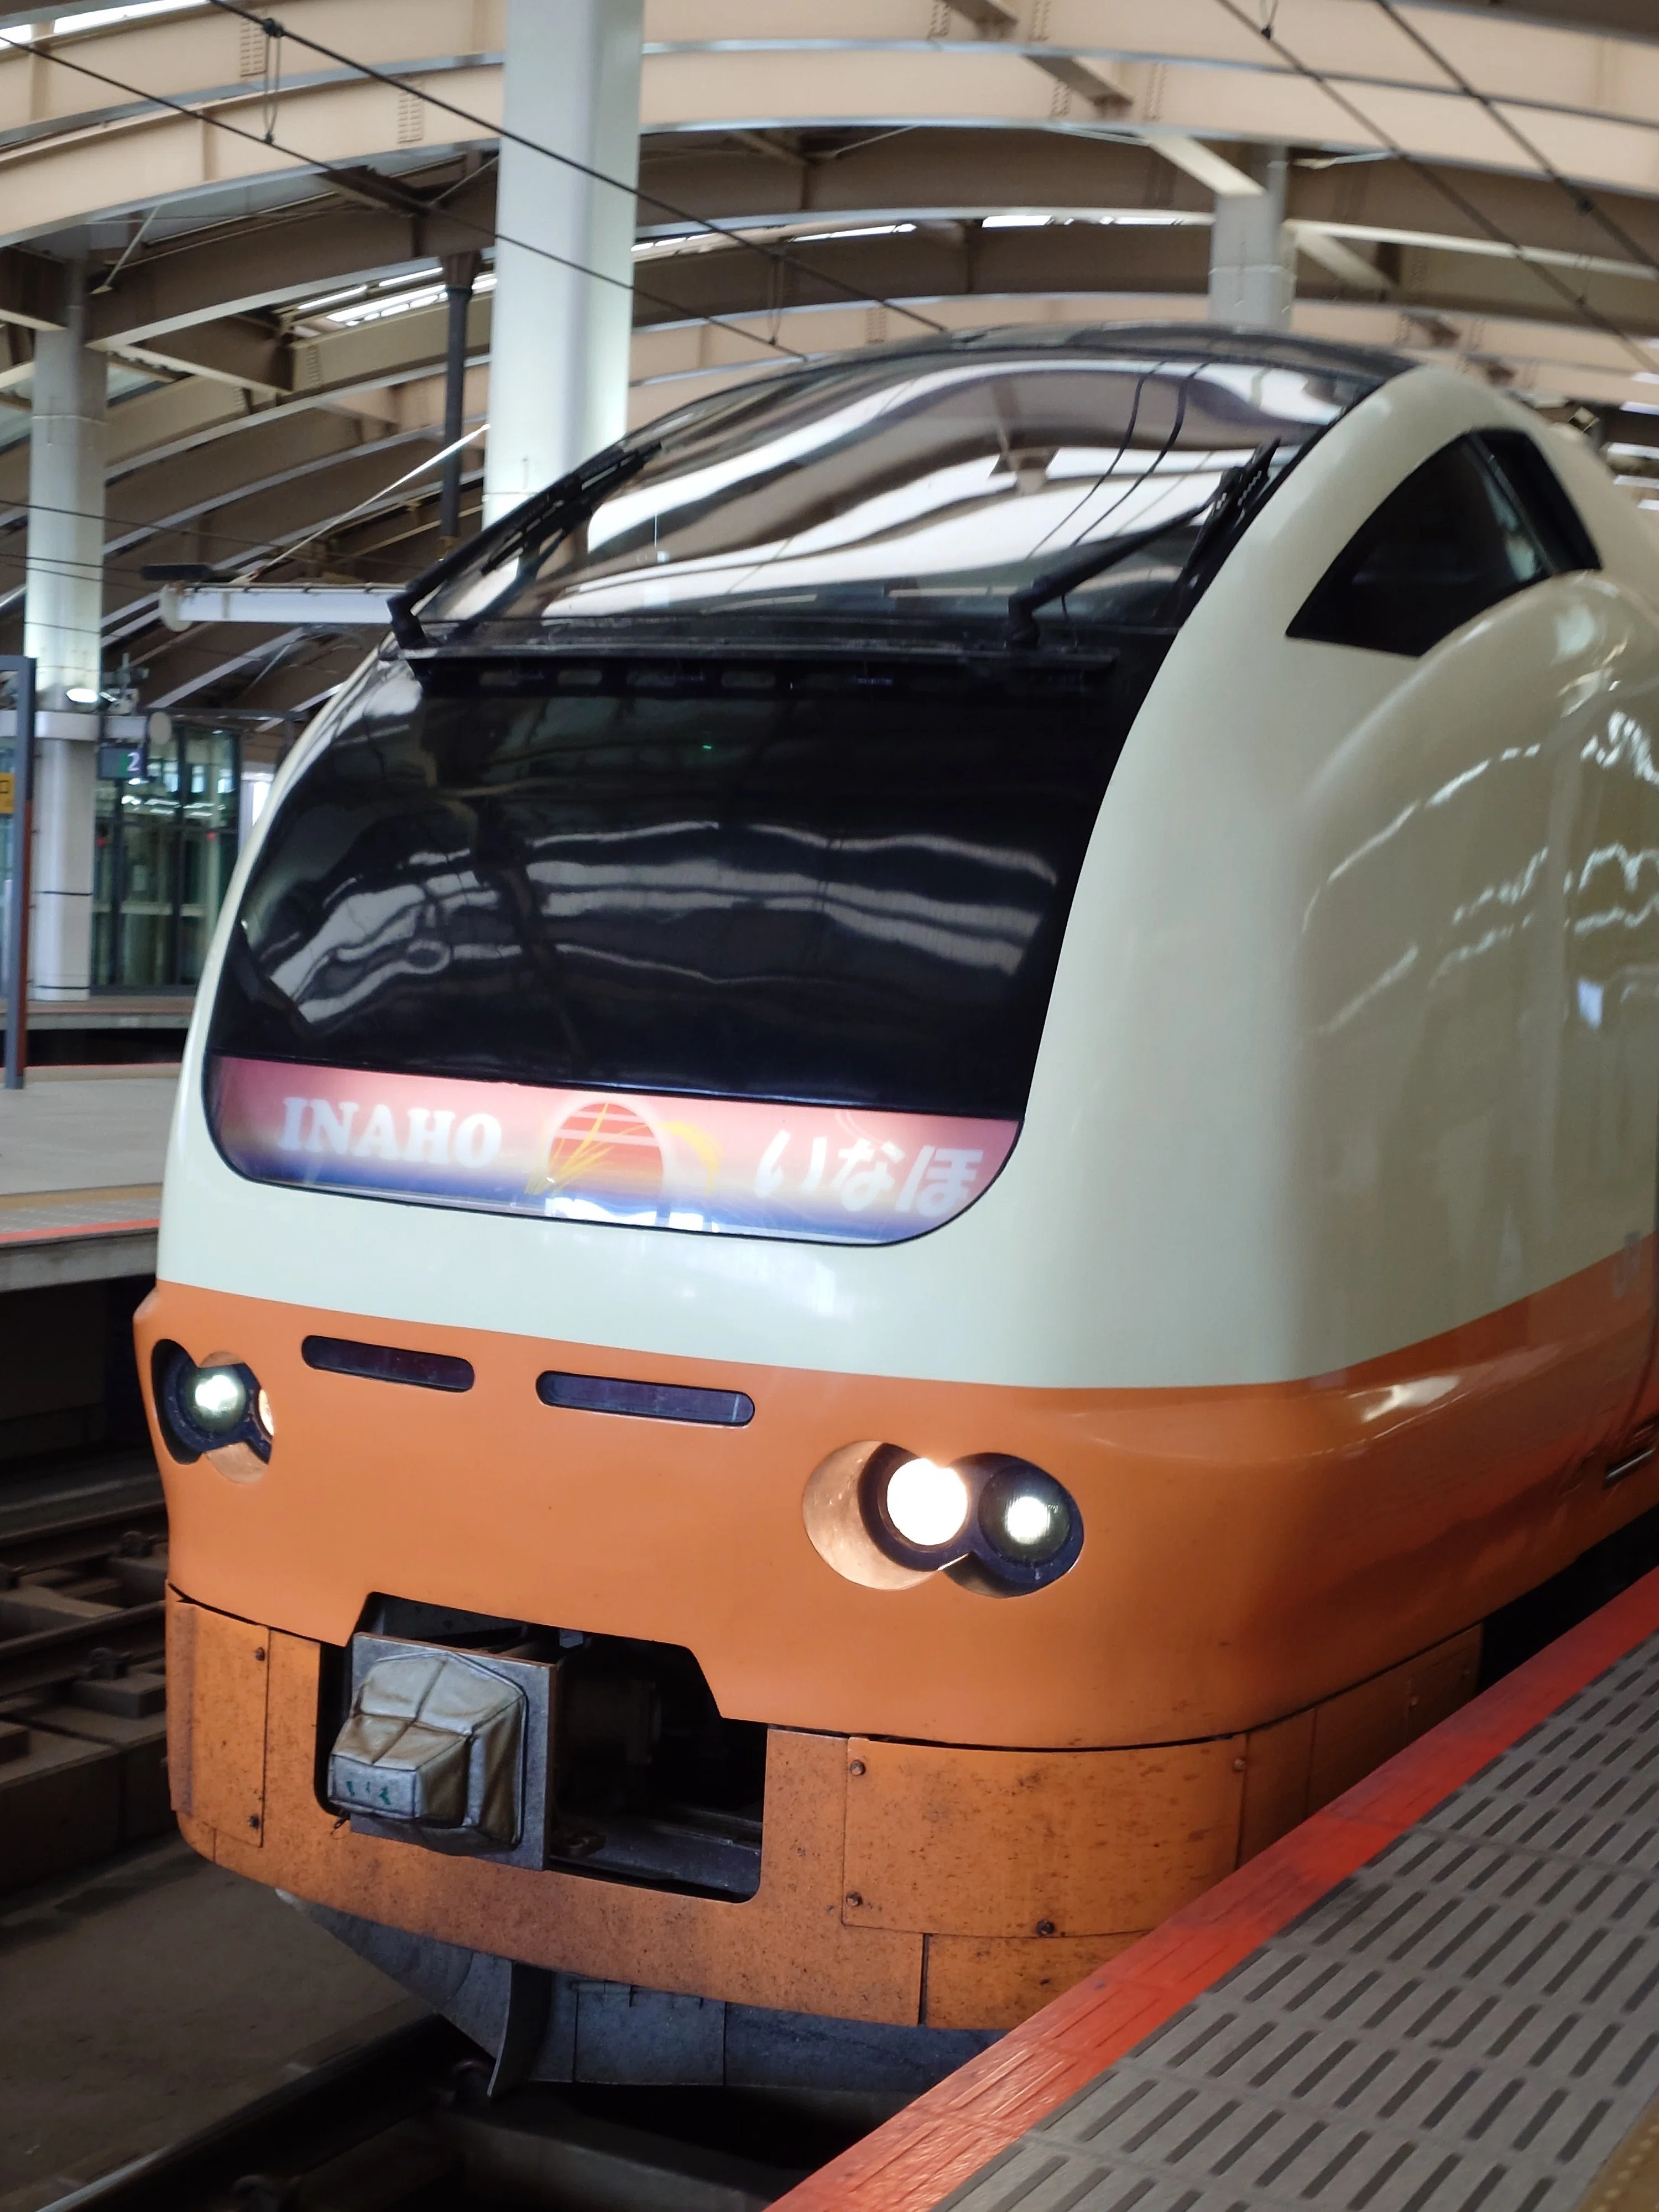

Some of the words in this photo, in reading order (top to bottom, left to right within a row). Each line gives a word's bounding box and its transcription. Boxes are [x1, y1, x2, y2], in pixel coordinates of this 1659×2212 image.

[127, 752, 140, 771] 2
[279, 1097, 502, 1168] INAHO
[753, 1129, 983, 1217] いなほ
